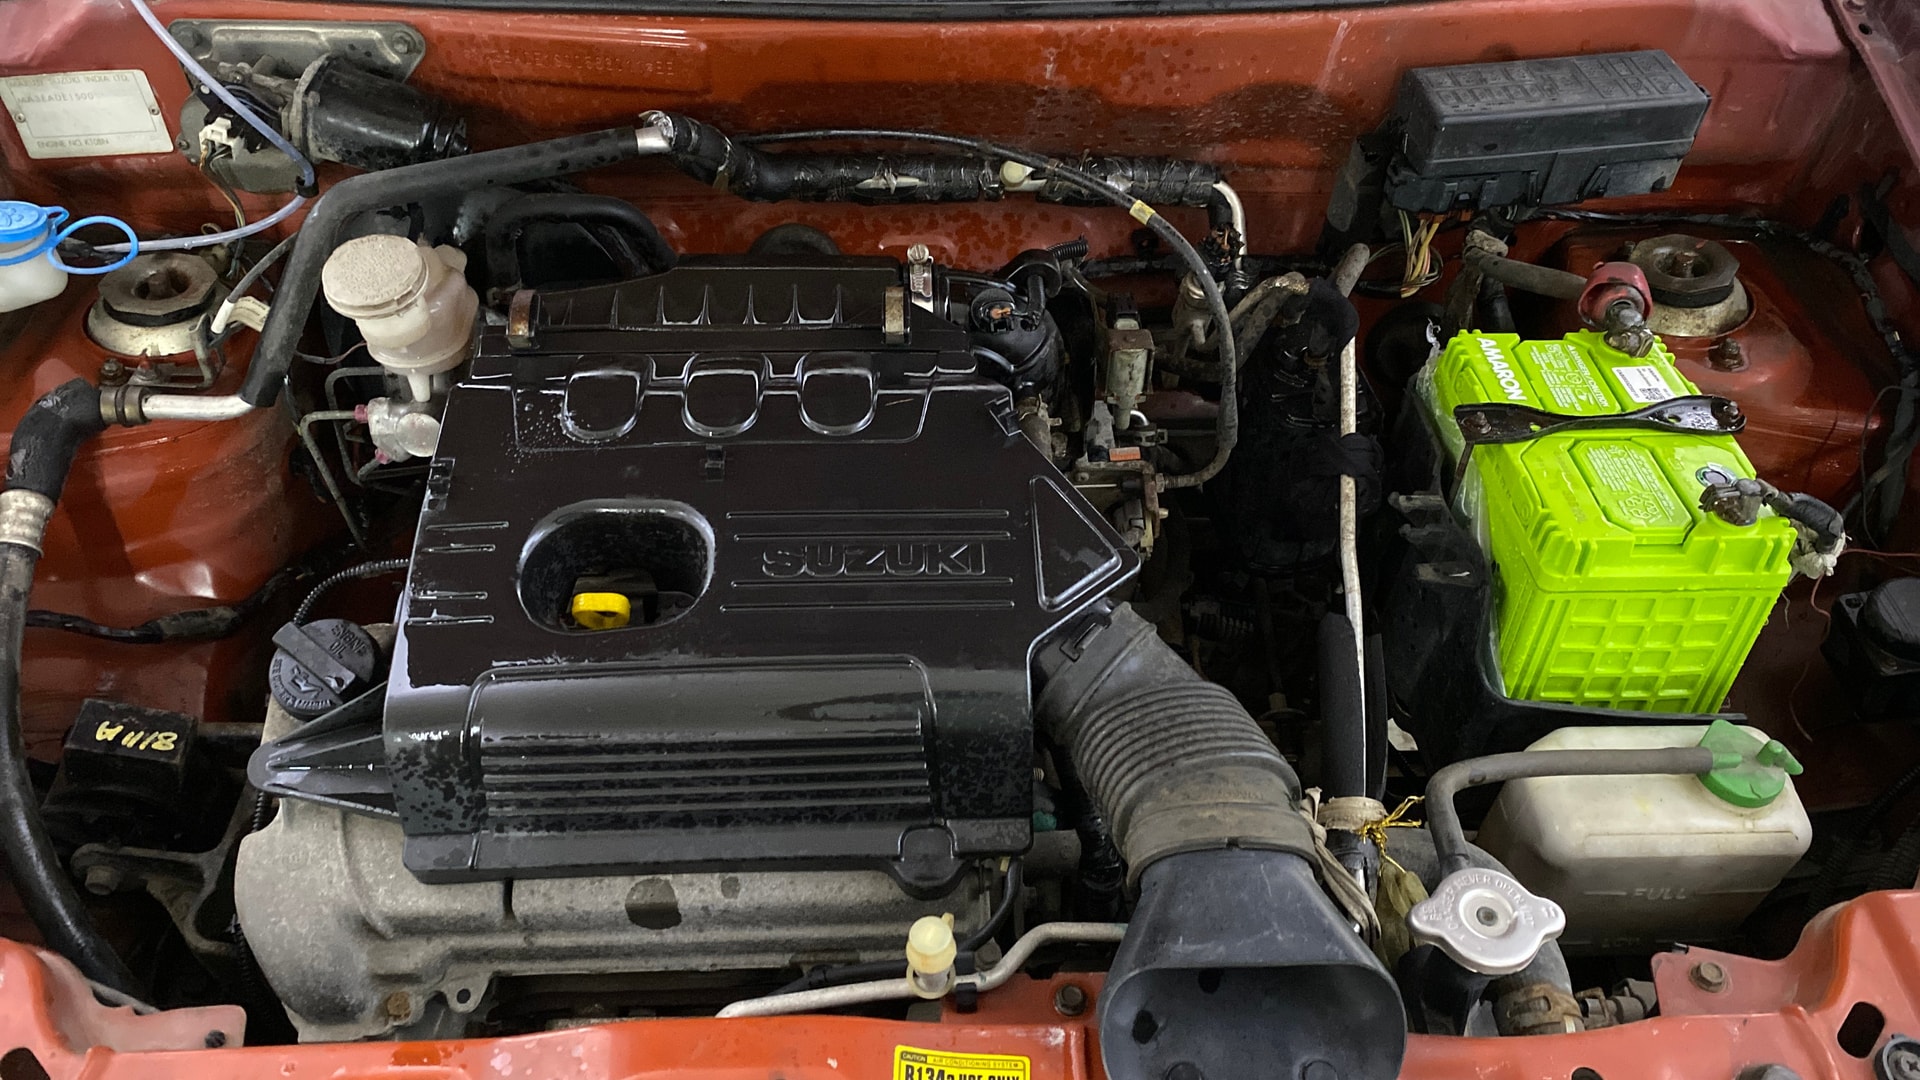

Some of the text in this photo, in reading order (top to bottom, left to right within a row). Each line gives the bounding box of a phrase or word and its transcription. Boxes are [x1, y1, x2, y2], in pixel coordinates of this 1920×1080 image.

[85, 74, 111, 83] INDIA
[1476, 337, 1527, 401] AMARON
[762, 543, 986, 578] SUZUKI
[331, 623, 368, 657] ENGINE
[1453, 873, 1491, 891] NEVER
[1495, 878, 1526, 906] OPEN
[1634, 887, 1687, 901] FULL
[902, 1052, 927, 1063] CAUTION
[945, 1058, 991, 1067] CONDITIONING
[992, 1061, 1019, 1069] SYSTEM
